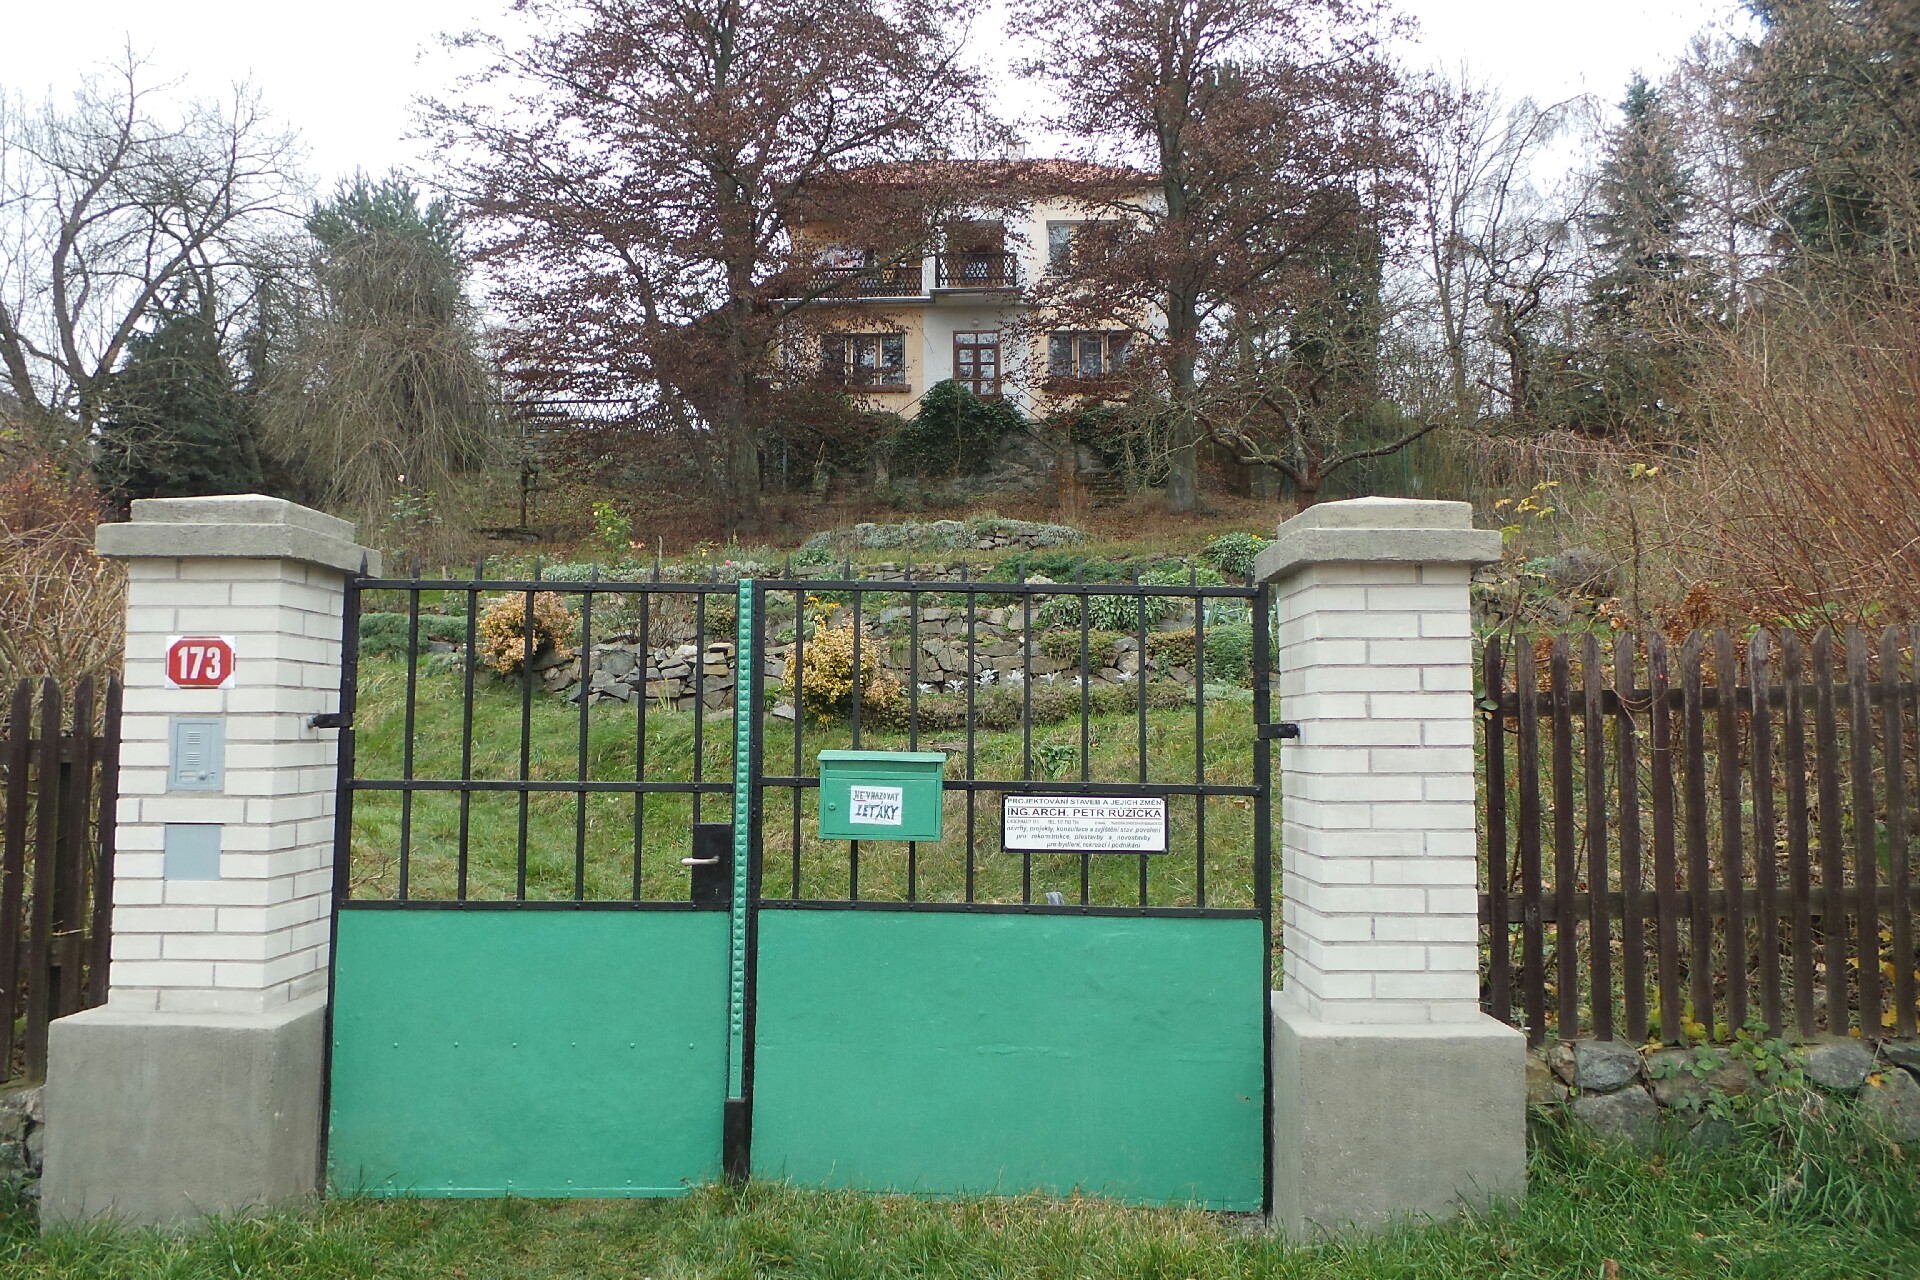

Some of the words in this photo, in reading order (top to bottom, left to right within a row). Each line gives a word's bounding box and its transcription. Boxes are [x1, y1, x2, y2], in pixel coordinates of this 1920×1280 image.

[178, 646, 221, 680] 173
[1073, 808, 1104, 817] PETR
[1108, 807, 1162, 818] RŮŽIČKA
